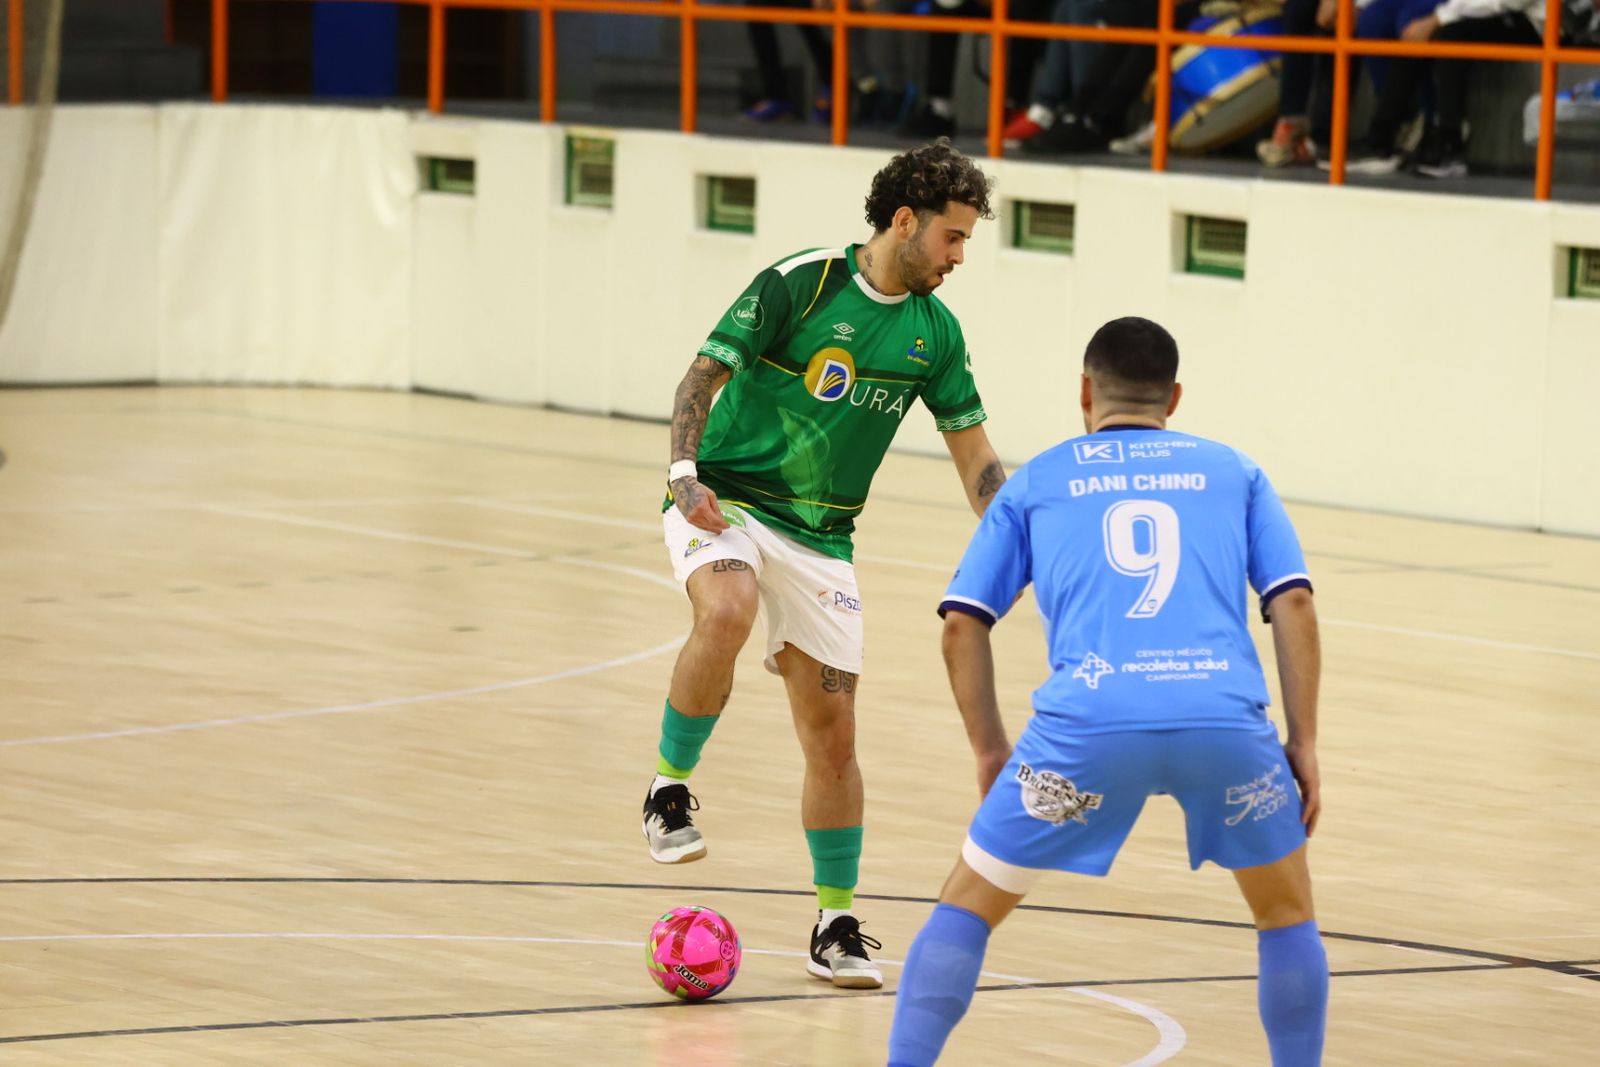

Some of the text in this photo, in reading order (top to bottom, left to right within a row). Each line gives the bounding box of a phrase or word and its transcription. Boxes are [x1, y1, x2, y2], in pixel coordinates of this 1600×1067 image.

[1129, 441, 1198, 450] KITCHEN
[1130, 449, 1171, 459] PLUS
[1069, 473, 1207, 497] DANI CHINO
[1103, 500, 1180, 618] 9
[1136, 650, 1175, 658] CENTRO
[1121, 659, 1229, 673] recoletas salud
